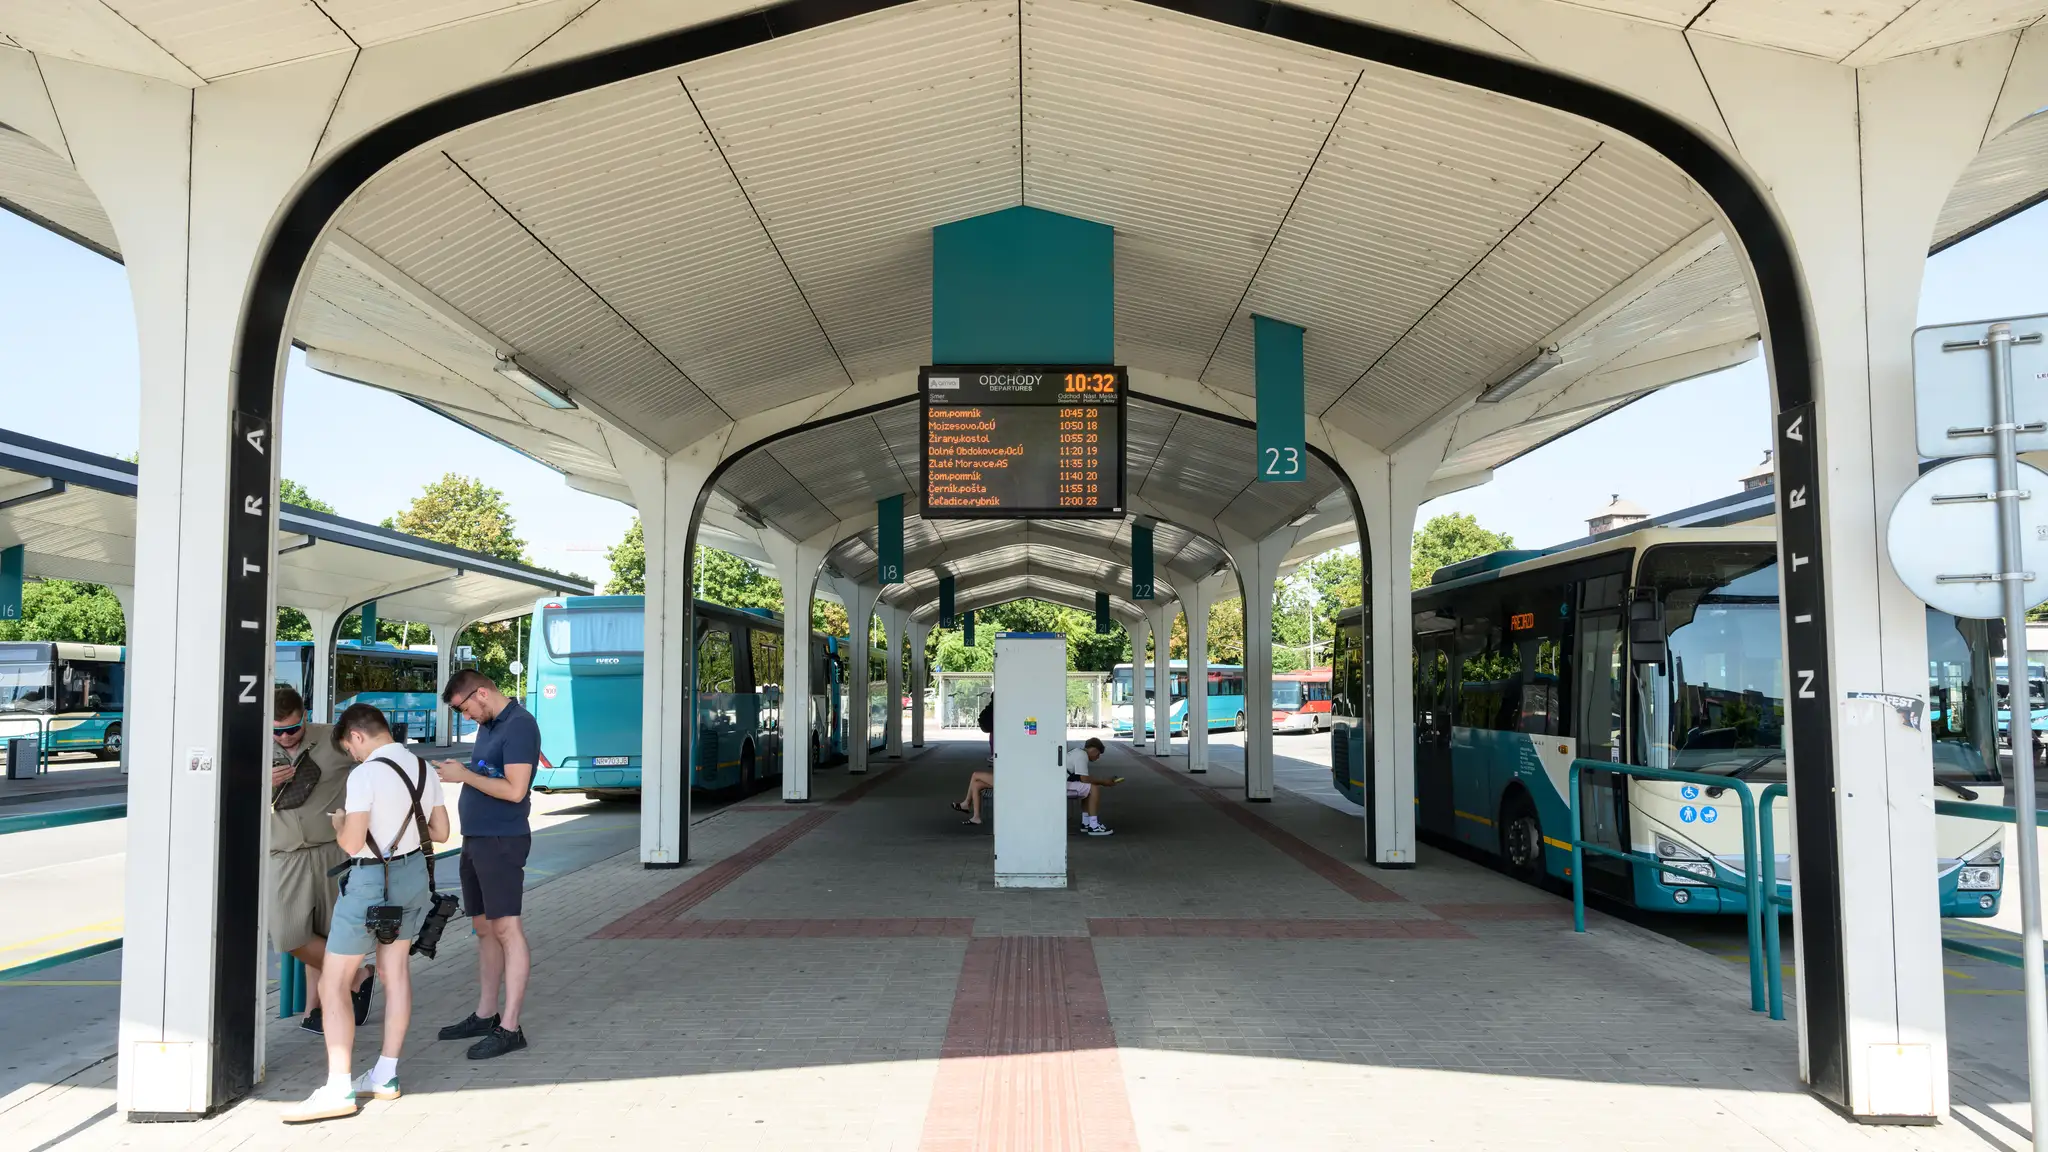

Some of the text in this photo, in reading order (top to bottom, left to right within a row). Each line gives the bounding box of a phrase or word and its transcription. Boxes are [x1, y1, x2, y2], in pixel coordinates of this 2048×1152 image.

[979, 375, 1042, 386] ODCHODY
[1065, 374, 1114, 392] 10:32
[1060, 409, 1083, 418] 10:45
[1086, 409, 1098, 418] 20
[1060, 421, 1083, 430] 10:50
[1087, 421, 1098, 430] 18
[1060, 434, 1083, 442] 10:55
[1086, 434, 1098, 442] 20
[928, 446, 954, 455] Dolné
[1060, 446, 1083, 455] 11:20
[1087, 446, 1098, 455] 19
[928, 459, 953, 468] Zlaté
[1060, 459, 1083, 468] 11:35
[1087, 459, 1098, 468] 19
[1266, 447, 1298, 475] 23
[1060, 472, 1083, 480] 11:40
[1086, 472, 1098, 480] 20
[1060, 484, 1083, 493] 11:55
[1087, 484, 1098, 493] 18
[1060, 497, 1083, 506] 12:00
[1086, 497, 1098, 506] 23
[1786, 415, 1816, 699] NITRA
[238, 429, 266, 704] NITRA
[883, 565, 897, 580] 18
[1136, 584, 1151, 597] 22
[3, 604, 14, 617] 16
[944, 618, 951, 627] 19
[1099, 624, 1107, 632] 21
[363, 636, 372, 644] 15
